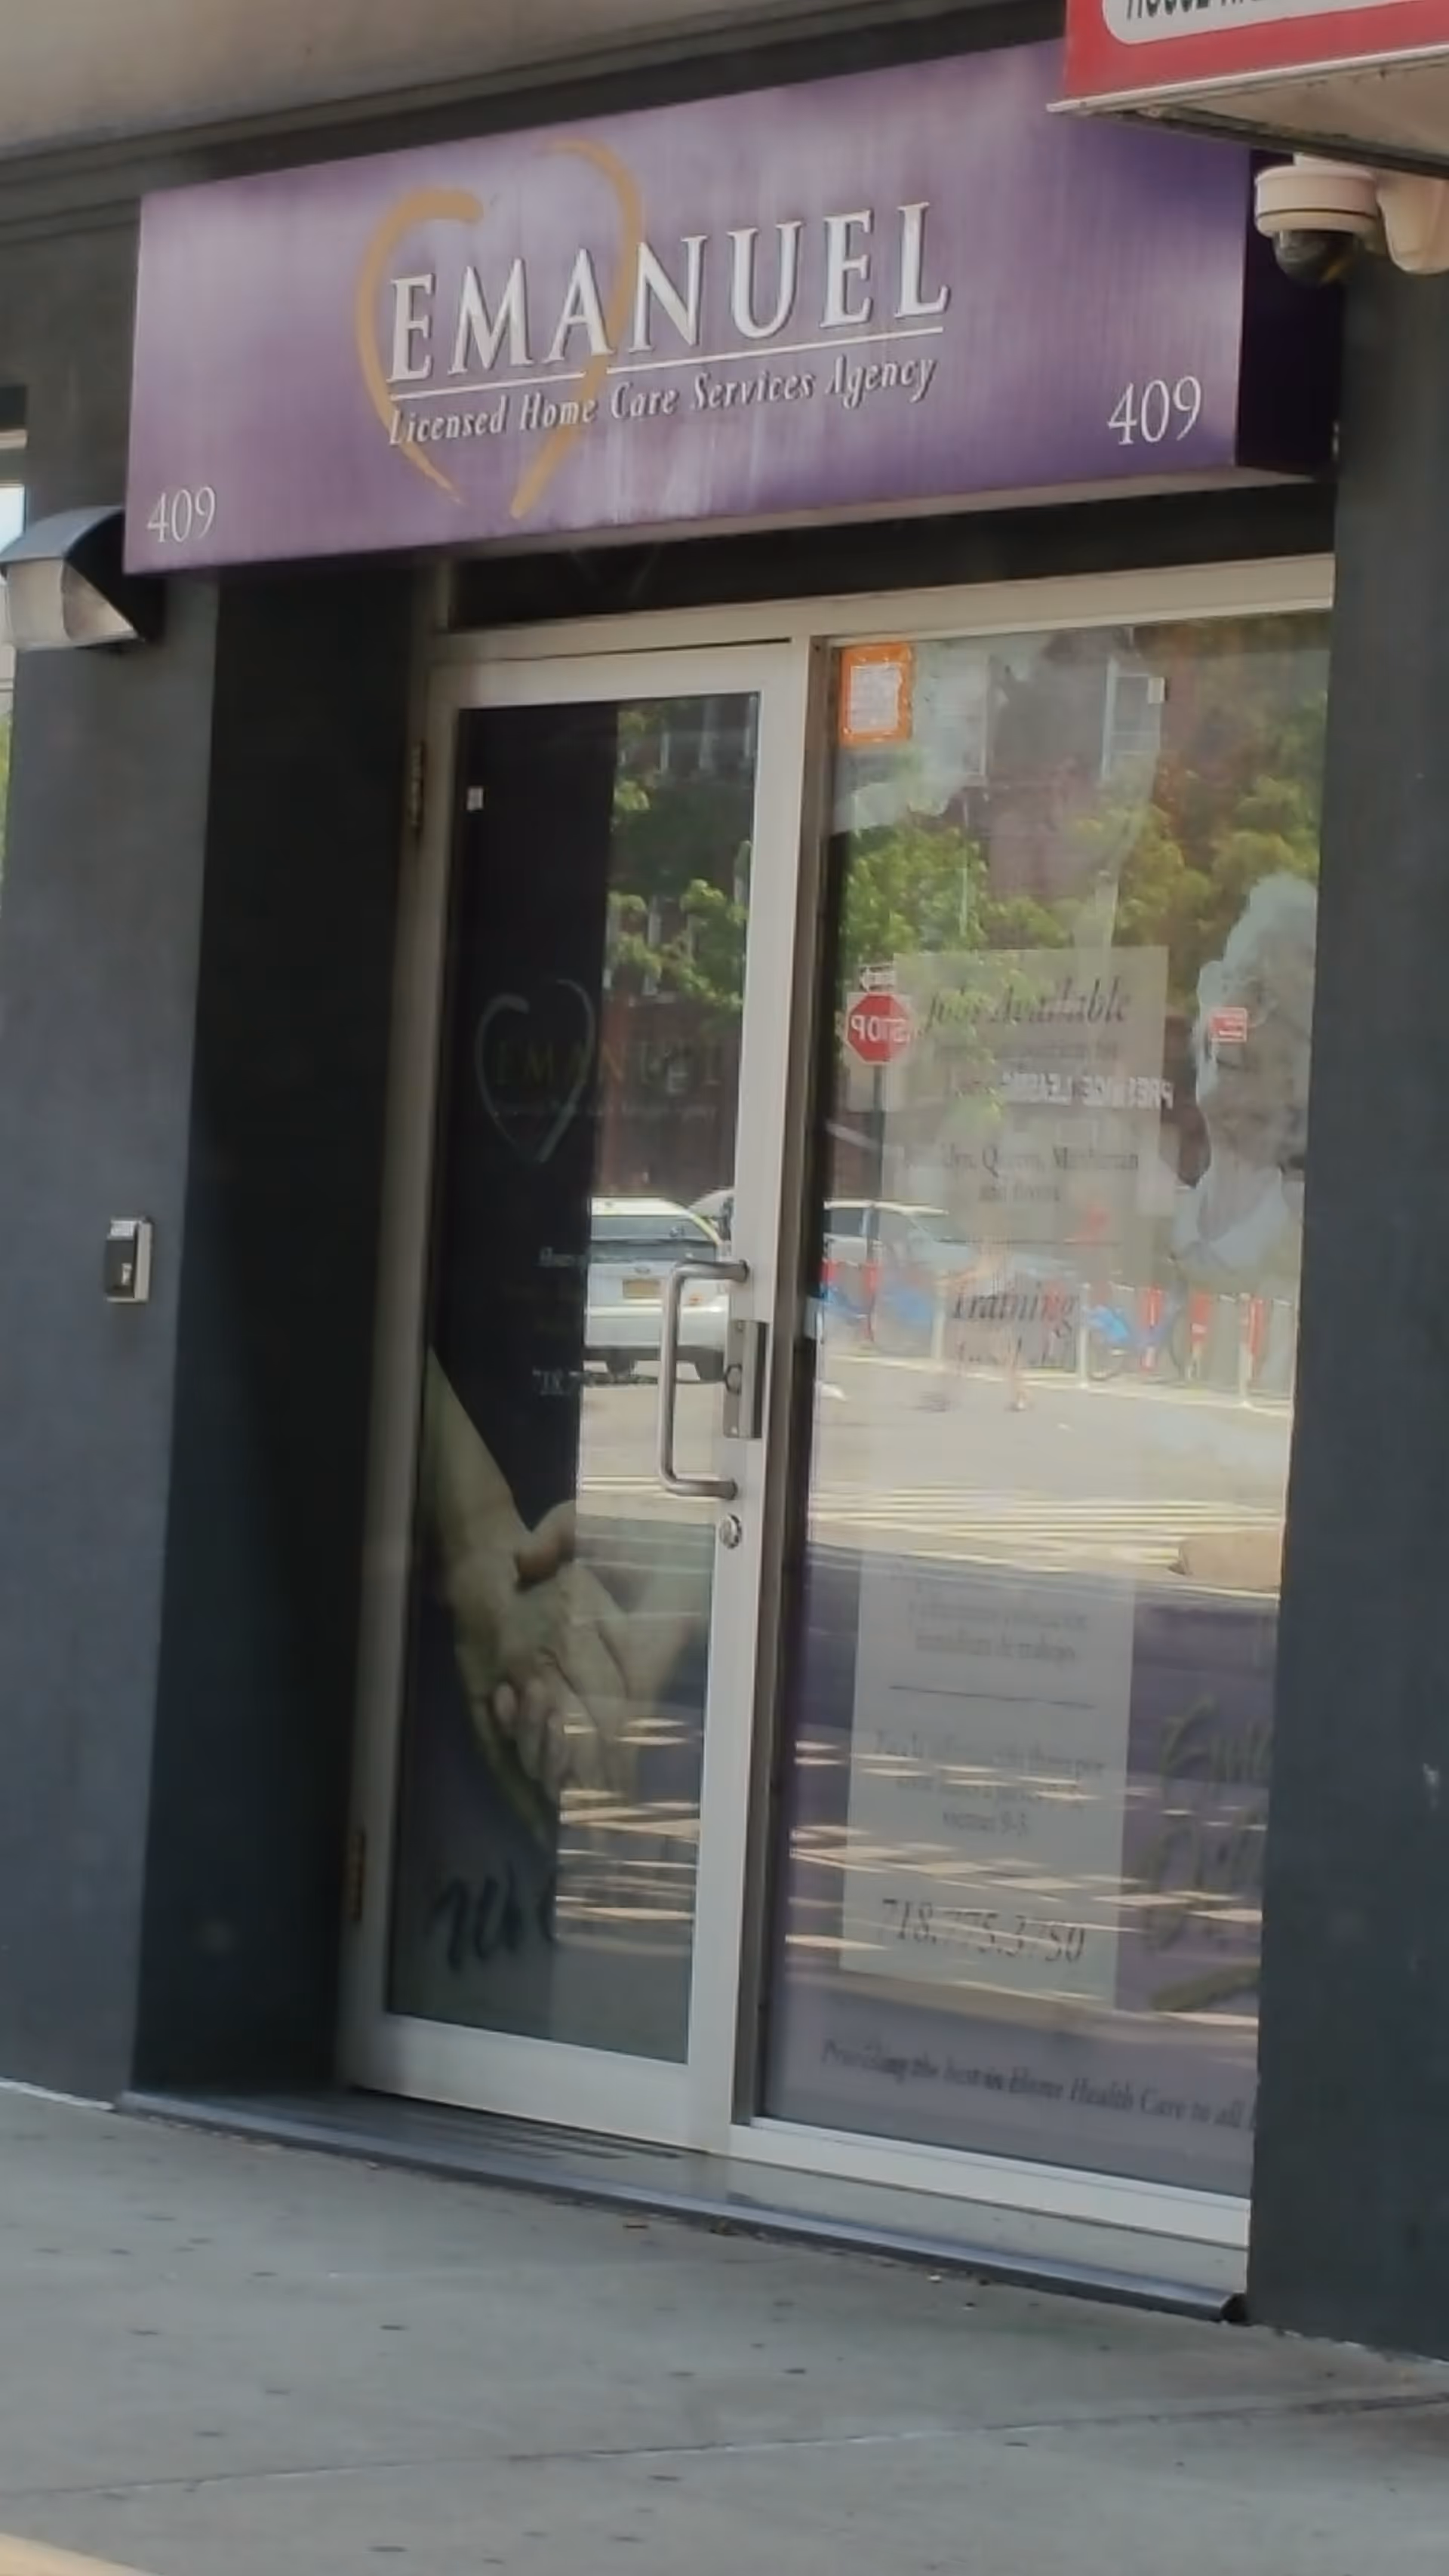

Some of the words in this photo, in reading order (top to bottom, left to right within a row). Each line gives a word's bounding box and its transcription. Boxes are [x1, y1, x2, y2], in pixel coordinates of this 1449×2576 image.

[386, 202, 951, 383] EMANUEL
[388, 395, 509, 447] Licensed
[519, 391, 596, 432] Home
[611, 381, 679, 420] Care
[688, 368, 816, 413] Services
[825, 353, 938, 410] Agency
[1107, 375, 1201, 445] 409
[146, 486, 216, 543] 409
